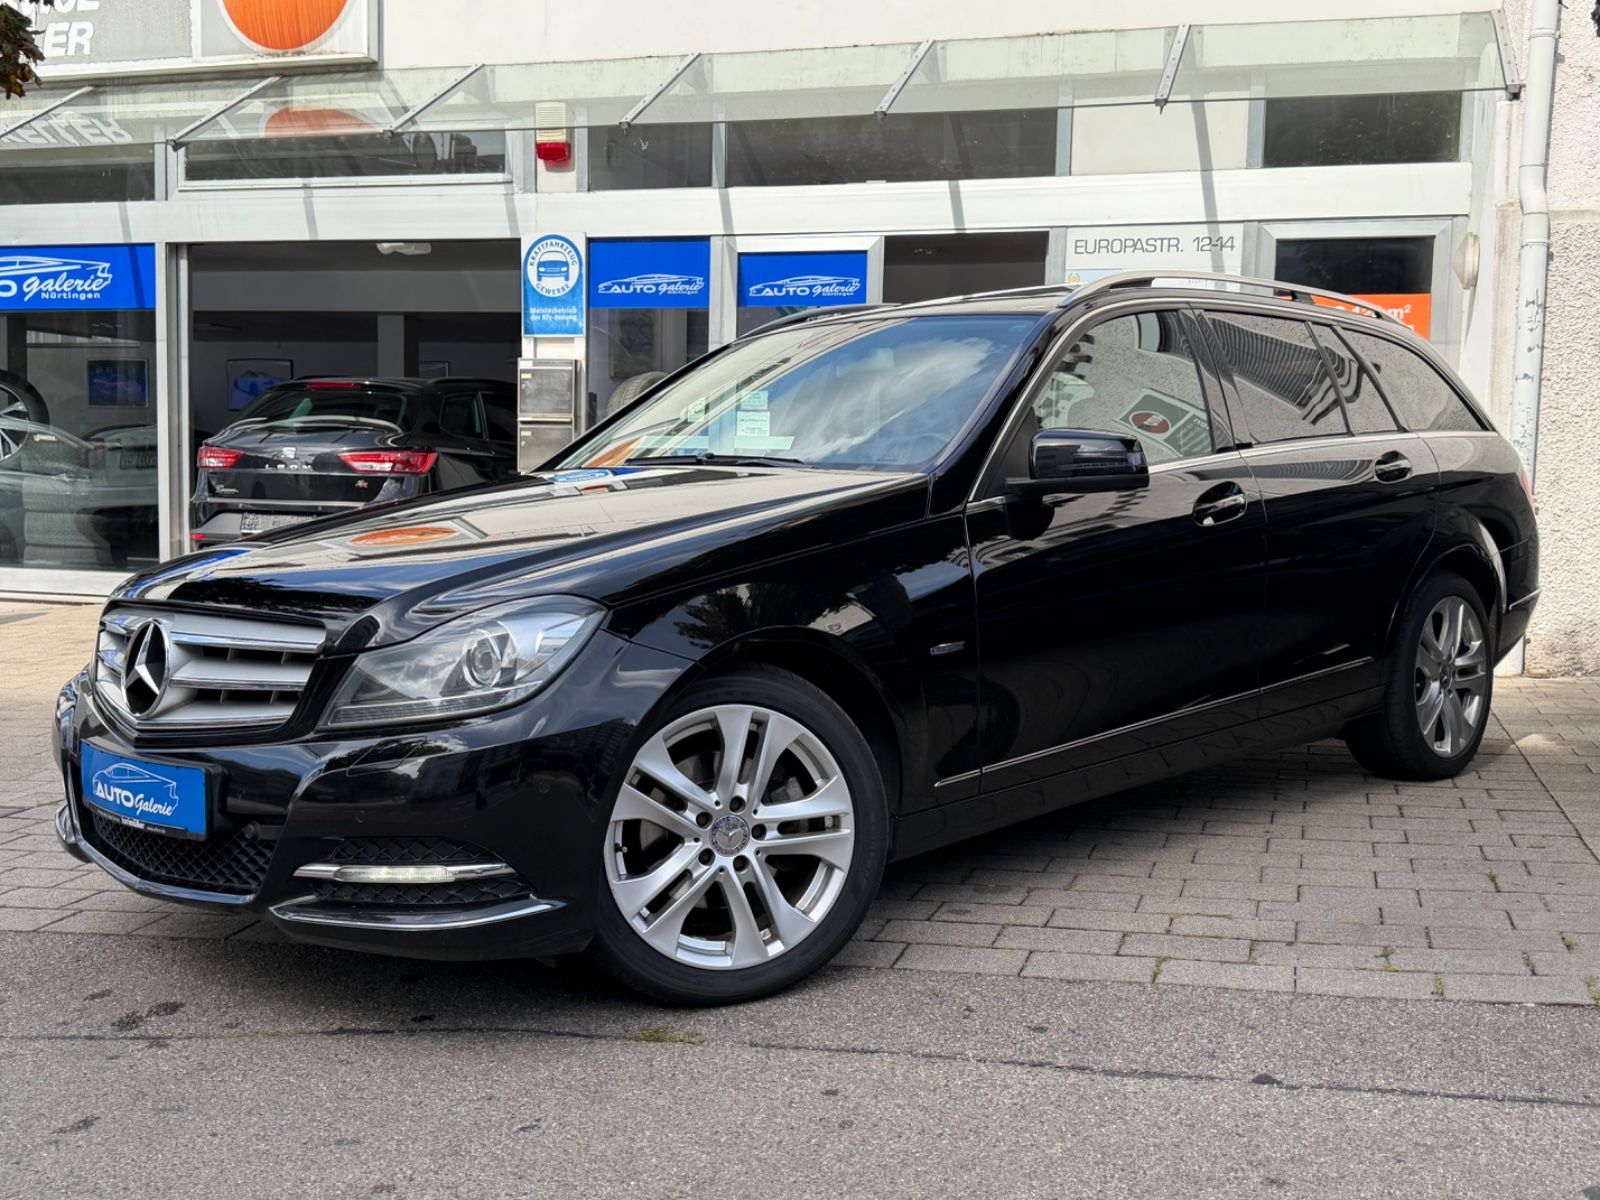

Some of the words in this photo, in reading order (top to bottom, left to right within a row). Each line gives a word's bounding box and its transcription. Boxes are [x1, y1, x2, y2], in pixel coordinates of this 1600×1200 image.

[529, 241, 578, 266] KRAFTFAHRZEUG
[1074, 238, 1184, 255] EUROPASTR.
[1192, 236, 1235, 252] 12-14
[23, 272, 108, 301] galerie
[536, 283, 570, 296] GEWERBE
[610, 285, 656, 293] AUTO
[658, 282, 703, 295] galerie
[761, 287, 810, 296] AUTO
[812, 284, 858, 297] galerie
[41, 291, 100, 300] Nürtingen
[95, 782, 134, 808] AUTO
